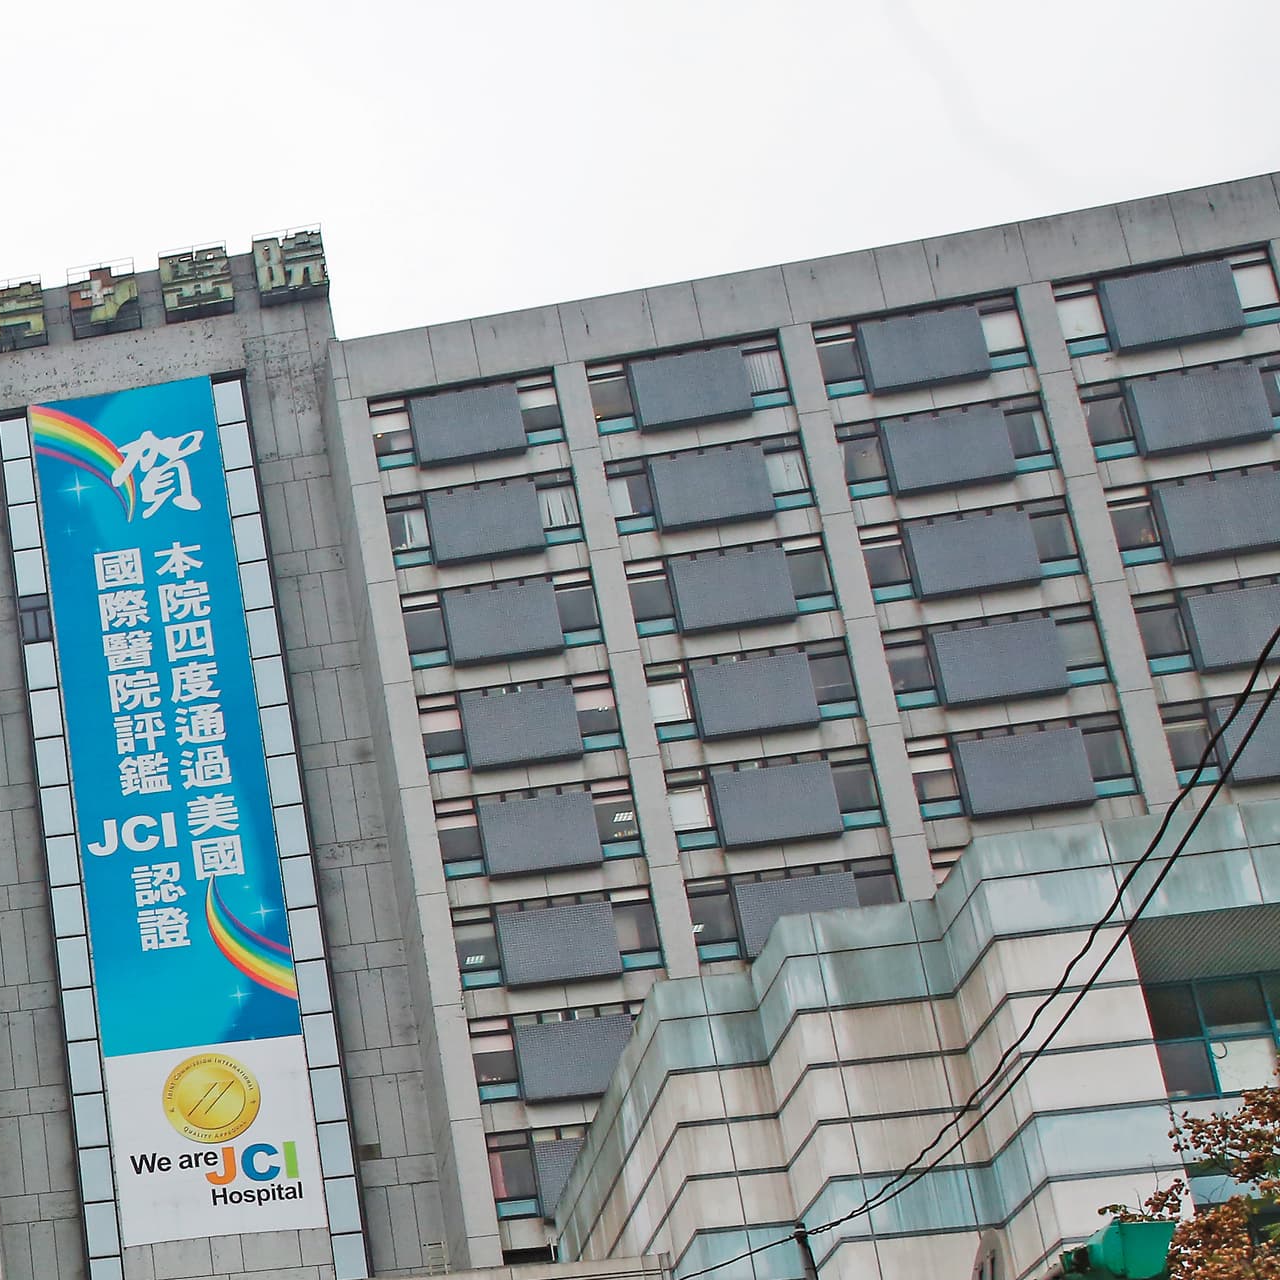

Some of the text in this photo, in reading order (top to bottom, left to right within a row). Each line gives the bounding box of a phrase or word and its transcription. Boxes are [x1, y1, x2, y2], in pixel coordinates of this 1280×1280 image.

[111, 429, 204, 519] 賀
[155, 541, 246, 880] 本院四度通過美國
[130, 1140, 299, 1187] We are JCI
[211, 1181, 304, 1207] Hospital
